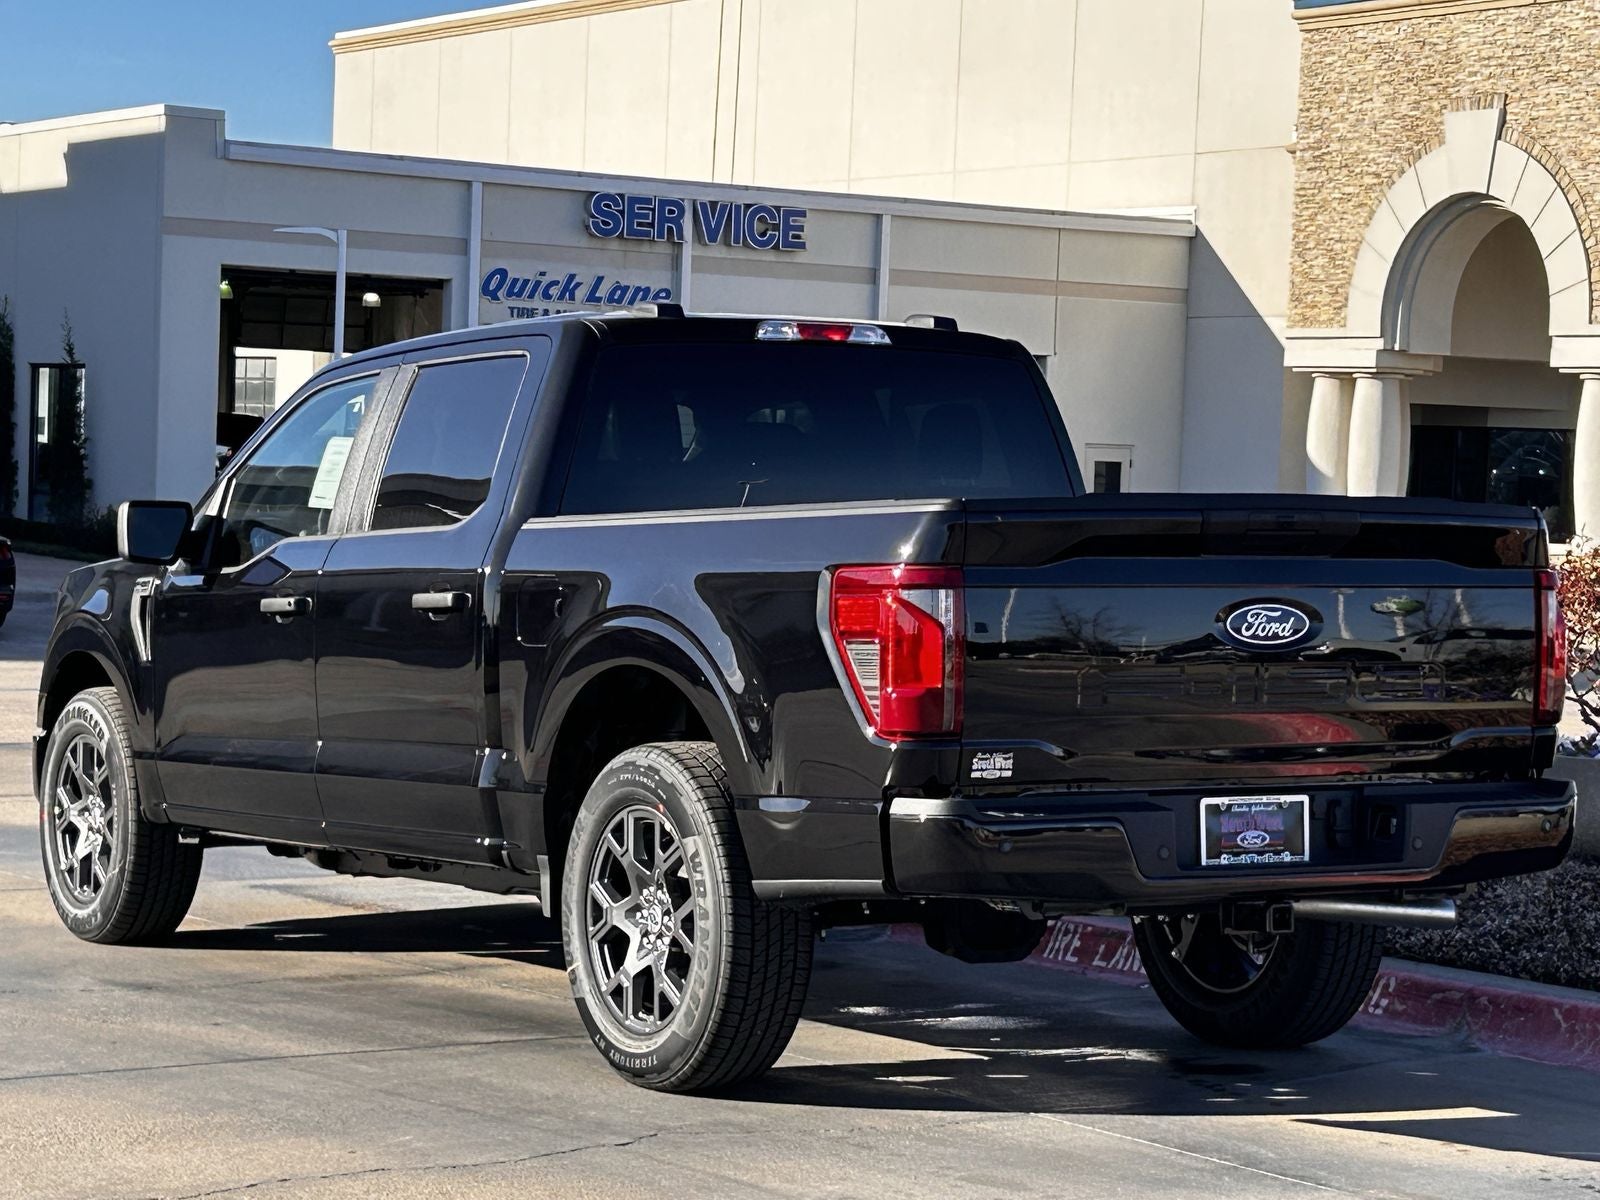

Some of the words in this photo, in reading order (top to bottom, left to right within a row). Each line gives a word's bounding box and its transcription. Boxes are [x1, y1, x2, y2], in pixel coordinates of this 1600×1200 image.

[588, 192, 808, 251] SERVICE
[481, 268, 582, 304] Quick
[584, 275, 673, 306] Lane
[1241, 609, 1295, 637] Ford
[1043, 919, 1083, 962] IRE
